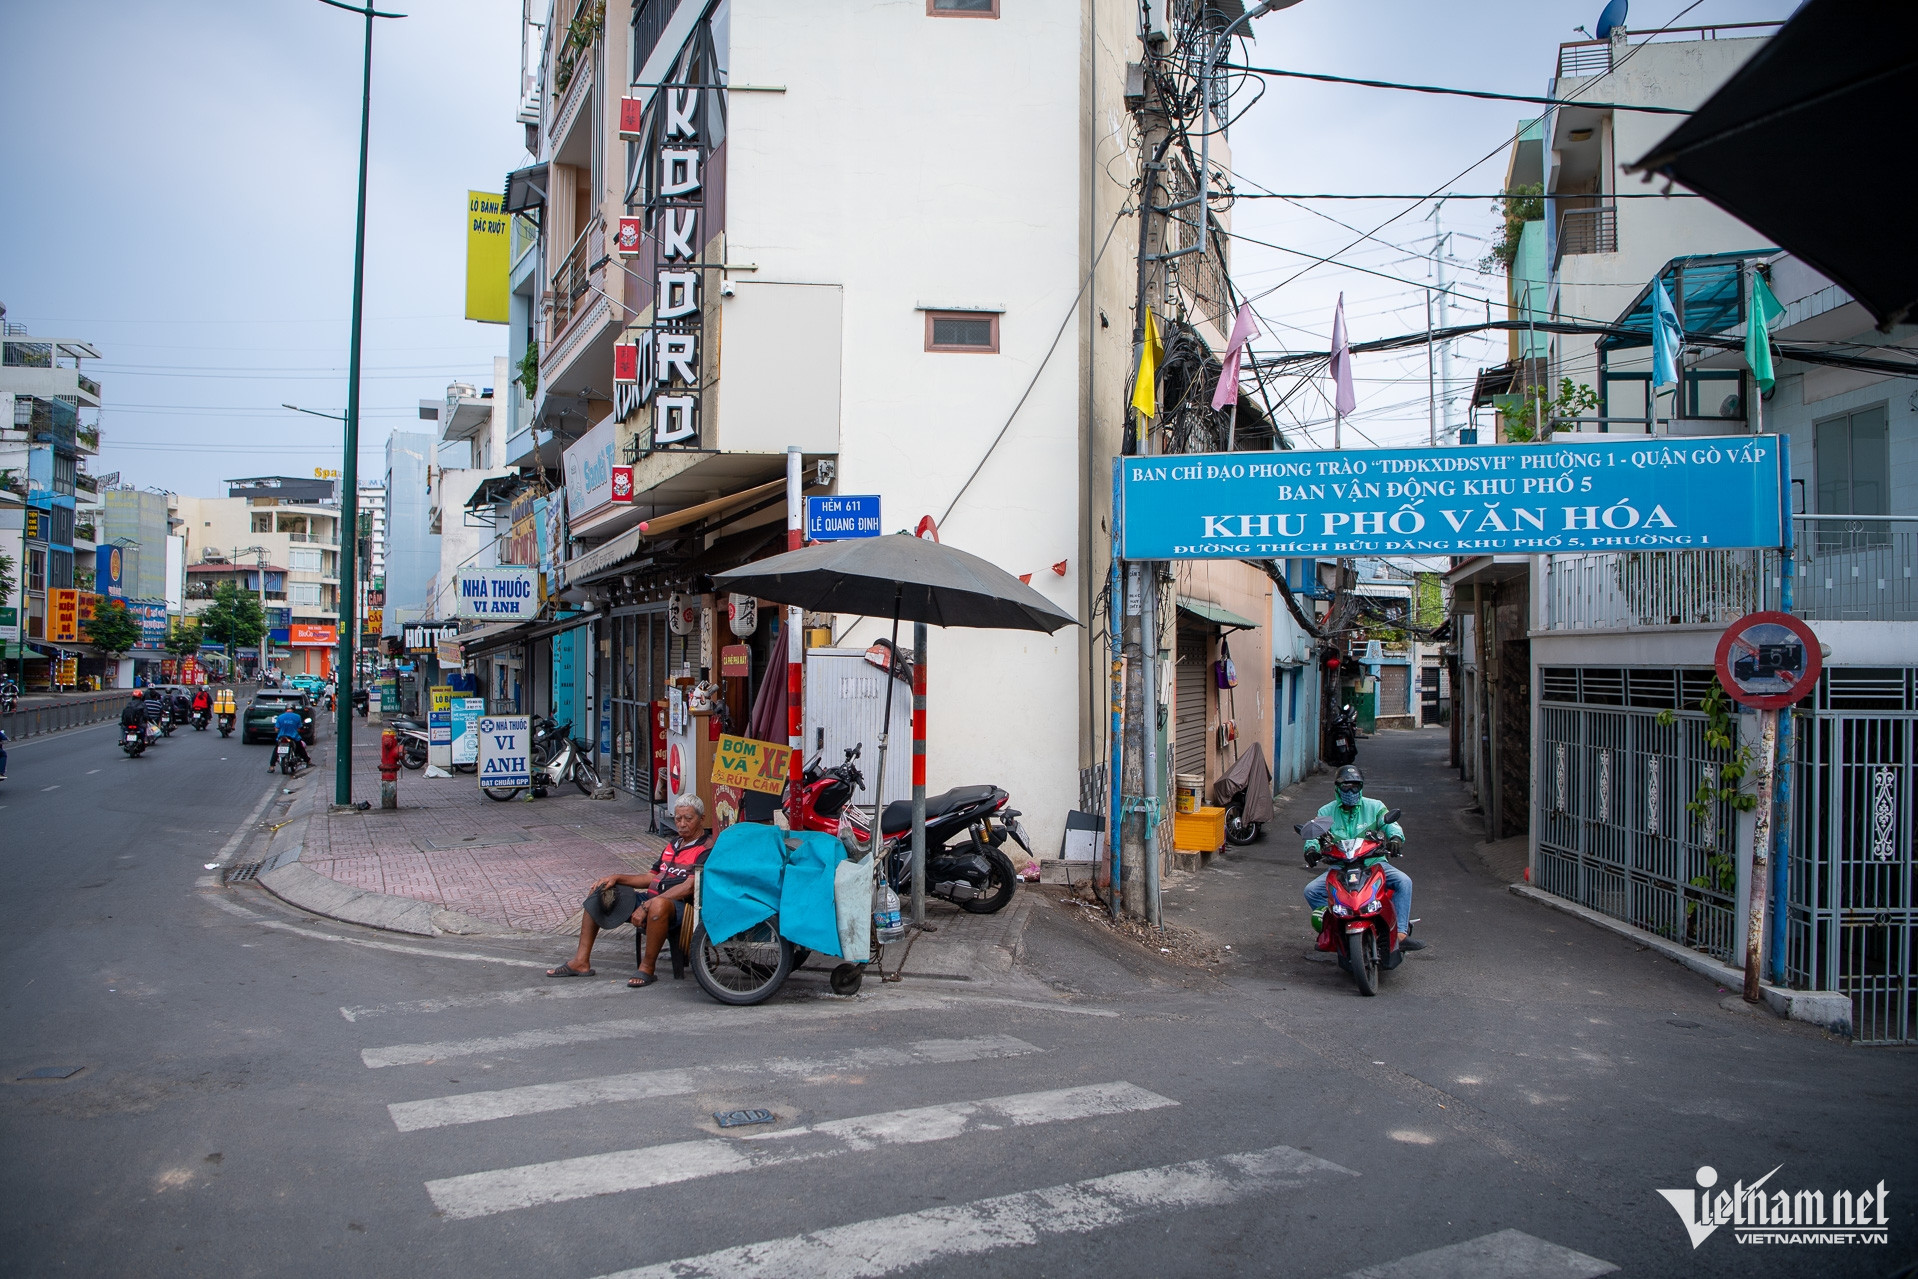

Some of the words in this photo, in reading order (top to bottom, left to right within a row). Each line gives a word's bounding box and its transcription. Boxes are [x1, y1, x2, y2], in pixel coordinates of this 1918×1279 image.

[481, 199, 498, 215] BÁNH
[1132, 467, 1167, 482] BAN
[1172, 462, 1203, 480] CHỈ
[1207, 464, 1244, 482] ĐẠO
[1249, 463, 1312, 478] PHONG
[1316, 457, 1367, 476] TRÀO
[1521, 450, 1601, 469] PHƯỜNG
[1607, 453, 1615, 467] 1
[1631, 447, 1686, 468] QUẬN
[1692, 446, 1721, 465] GÒ
[1726, 442, 1766, 463] VẤP
[314, 467, 337, 479] Spa
[1278, 484, 1325, 501] BAN
[1332, 479, 1380, 502] VẬN
[1386, 477, 1456, 501] ĐỘNG
[1463, 479, 1516, 496] KHU
[1522, 469, 1574, 494] PHỐ
[1580, 476, 1592, 492] 5
[822, 498, 842, 511] HẺM
[846, 501, 861, 511] 611
[811, 516, 822, 532] LÊ
[825, 518, 855, 531] QUANG
[858, 517, 879, 533] ĐỊNH
[1201, 513, 1308, 538] KHU
[1321, 499, 1425, 536] PHỐ
[1439, 501, 1547, 533] VĂN
[1561, 498, 1677, 531] HÓA
[1173, 542, 1251, 554] ĐƯỜNG
[1257, 541, 1328, 552] THÍCH
[1334, 540, 1379, 551] BỬU
[1385, 539, 1449, 550] ĐĂNG
[1457, 538, 1507, 549] KHU
[1513, 534, 1562, 547] PHỐ
[1568, 536, 1585, 547] 5,
[1591, 533, 1692, 546] PHƯỜNG
[1701, 535, 1709, 544] 1
[462, 576, 488, 598] NHÀ
[491, 574, 531, 598] THUỐC
[473, 601, 488, 613] VI
[491, 601, 520, 613] ANH
[405, 625, 432, 648] HỚT
[495, 720, 508, 731] NHÀ
[509, 718, 528, 731] THUỐC
[494, 735, 515, 750] VI
[484, 757, 526, 773] ANH
[722, 739, 757, 756] BƠM
[757, 746, 789, 780] XE
